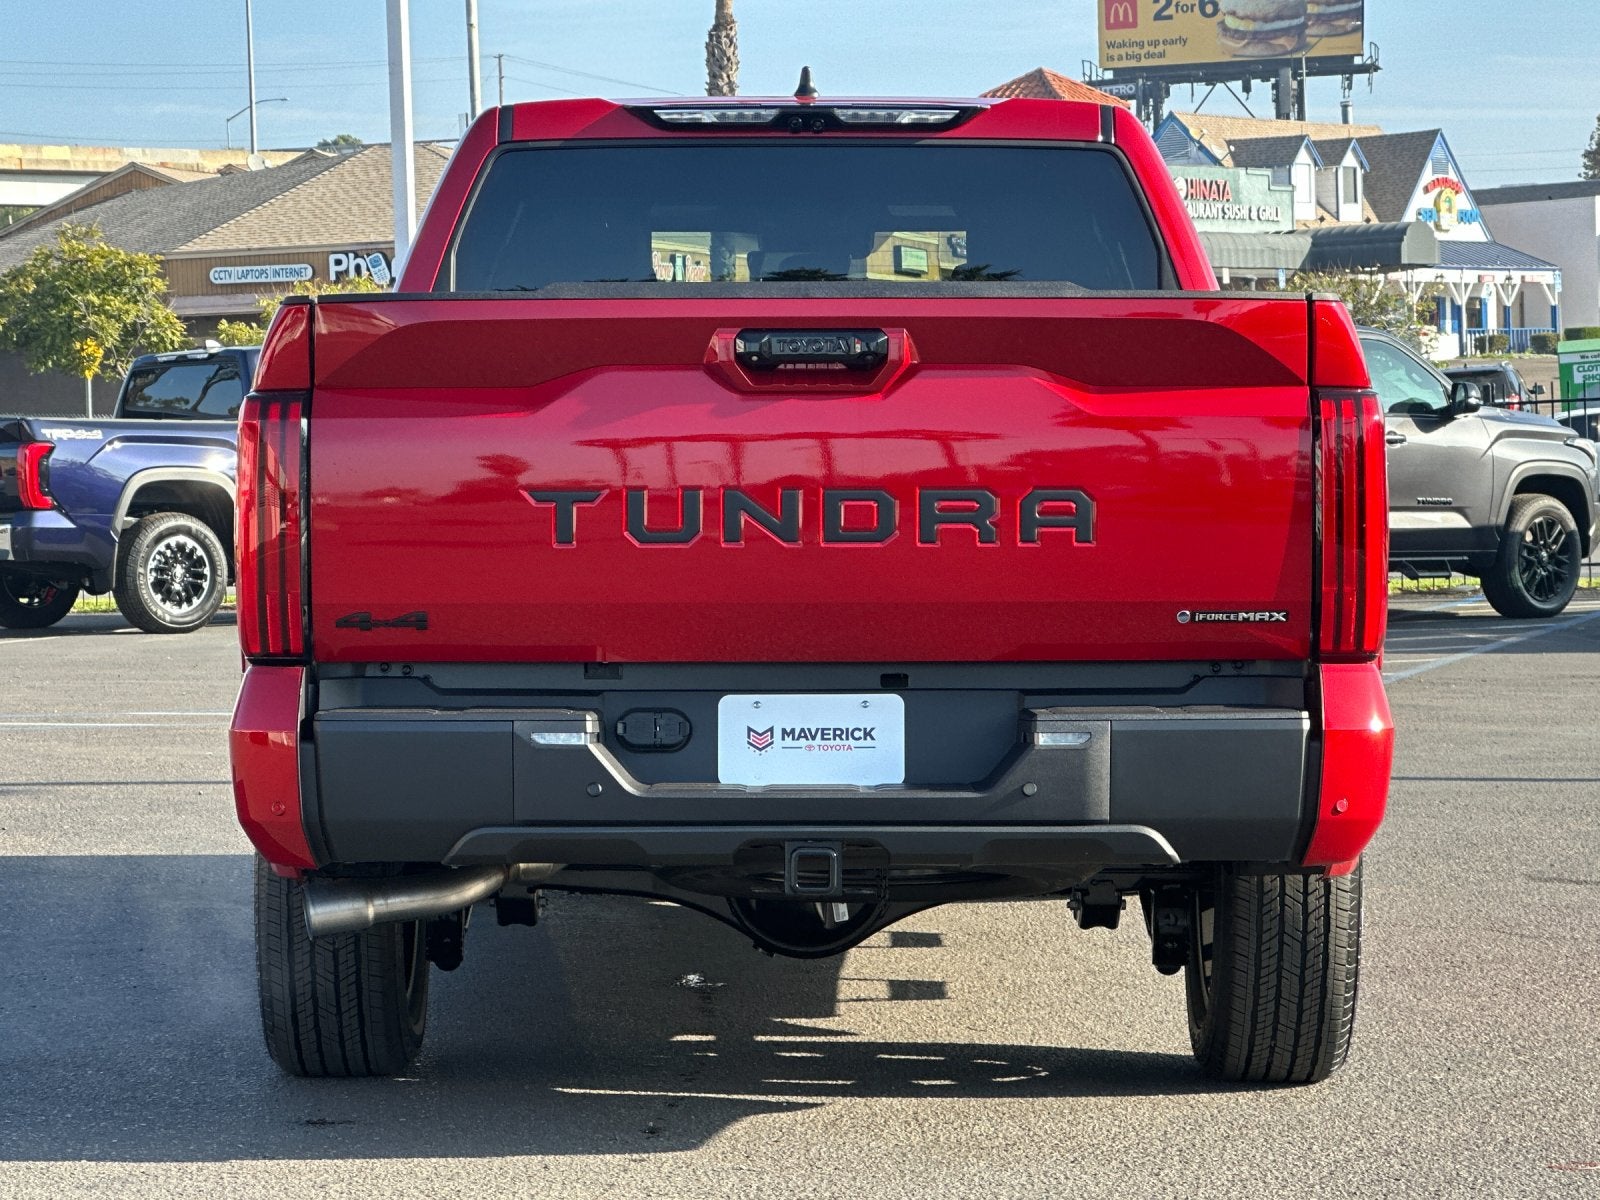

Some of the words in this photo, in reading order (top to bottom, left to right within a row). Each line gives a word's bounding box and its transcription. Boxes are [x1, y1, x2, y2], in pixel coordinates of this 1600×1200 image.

[1152, 0, 1174, 21] 2
[1174, 2, 1197, 14] for
[1198, 0, 1220, 18] 6
[1105, 38, 1145, 50] Waking
[1147, 40, 1161, 49] up
[1161, 36, 1188, 47] early
[1106, 53, 1115, 62] is
[1125, 51, 1142, 62] big
[1143, 50, 1166, 60] deal
[1186, 177, 1232, 202] HINATA
[1223, 204, 1249, 220] SUSHI
[213, 268, 233, 281] CCTV
[236, 267, 269, 280] LAPTOPS
[272, 266, 309, 279] INTERNET
[777, 336, 850, 353] TOYOTA
[519, 488, 1097, 548] TUNDRA
[781, 727, 876, 741] MAVERICK
[817, 744, 853, 752] TOYOTA
